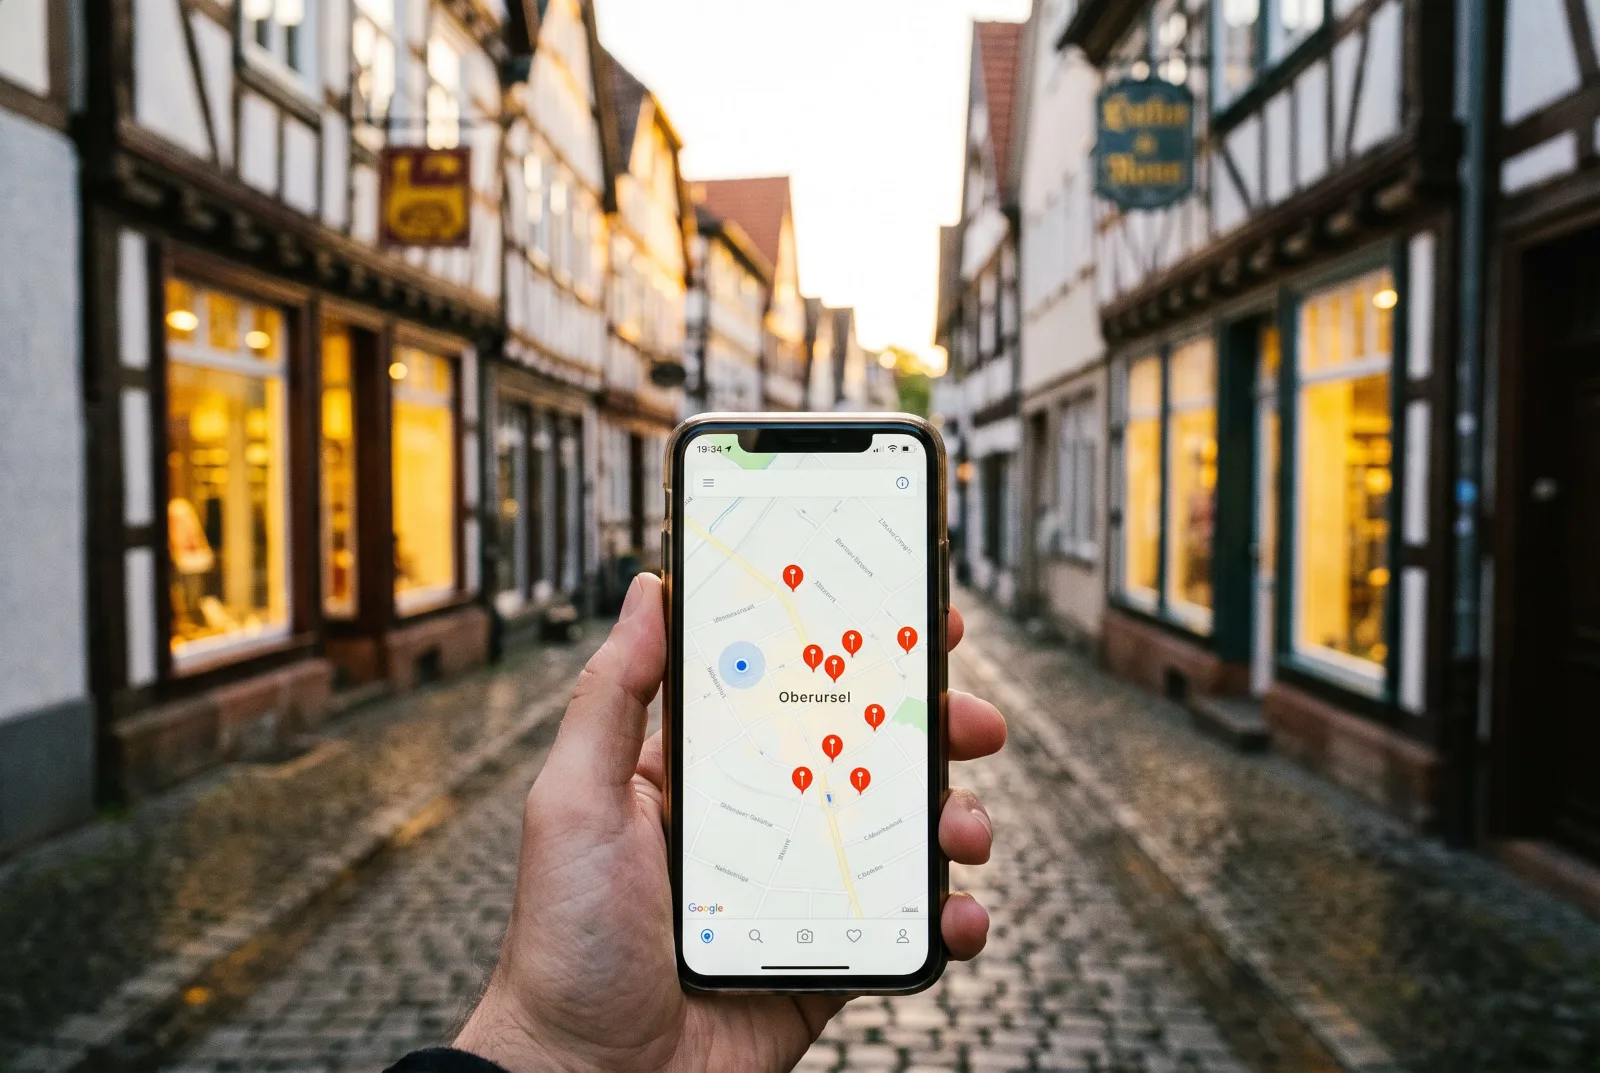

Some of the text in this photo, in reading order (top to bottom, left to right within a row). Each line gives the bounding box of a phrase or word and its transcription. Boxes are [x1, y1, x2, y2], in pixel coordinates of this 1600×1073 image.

[696, 445, 723, 453] 19:34
[779, 691, 851, 703] Oberursel
[688, 902, 724, 915] Google
